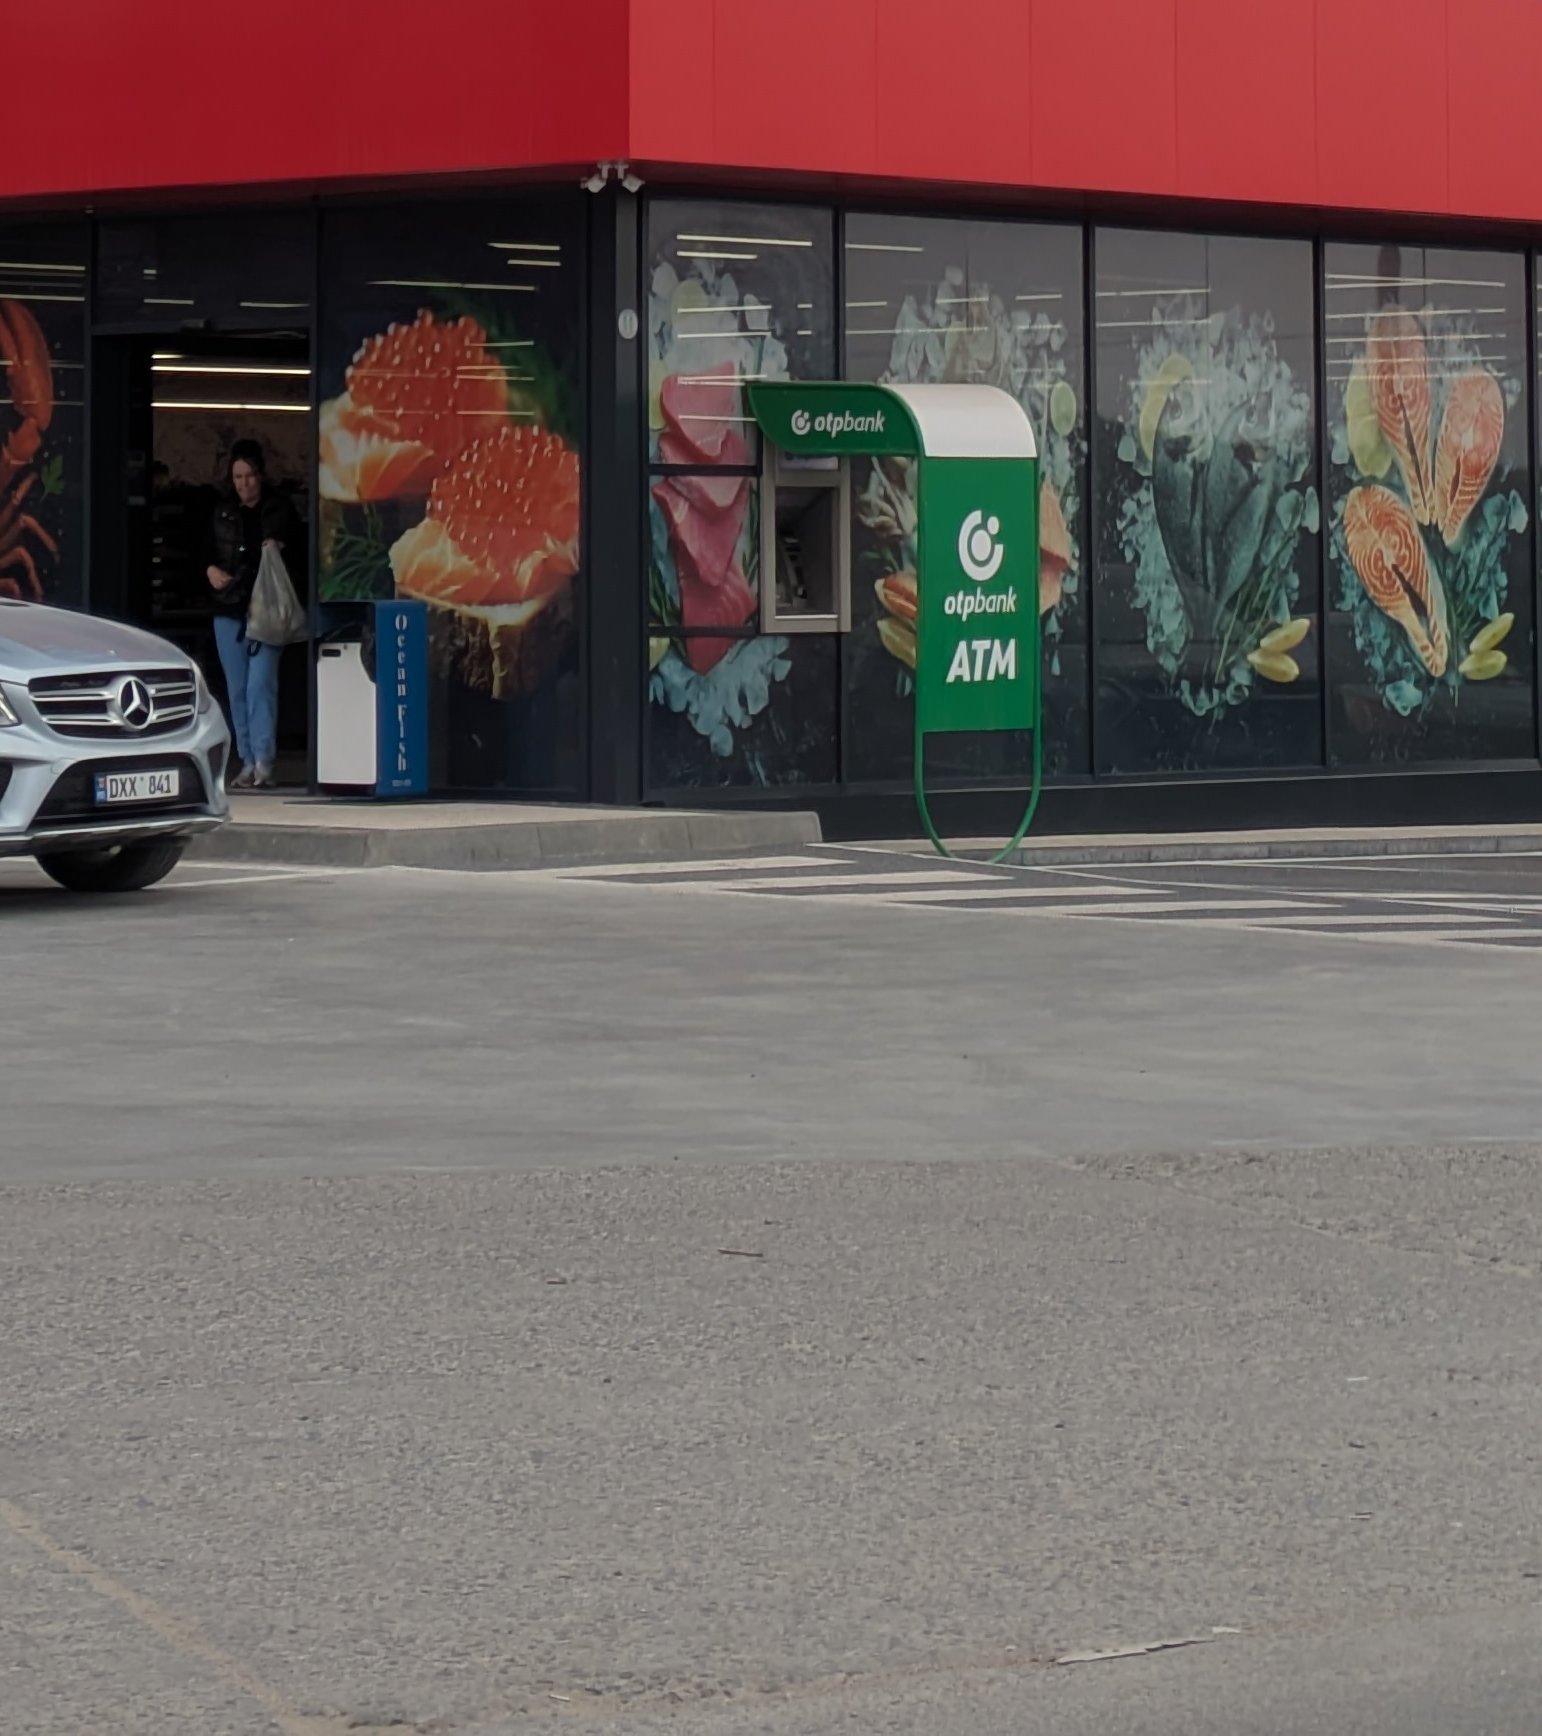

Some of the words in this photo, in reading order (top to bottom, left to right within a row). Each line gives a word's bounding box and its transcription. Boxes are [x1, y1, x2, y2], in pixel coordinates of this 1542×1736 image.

[814, 409, 886, 439] otpbank
[944, 586, 1017, 623] otpbank
[395, 614, 408, 697] Ocean
[945, 638, 1017, 684] ATM
[397, 704, 408, 772] Fish
[109, 775, 137, 799] DXX
[148, 773, 171, 795] 841
